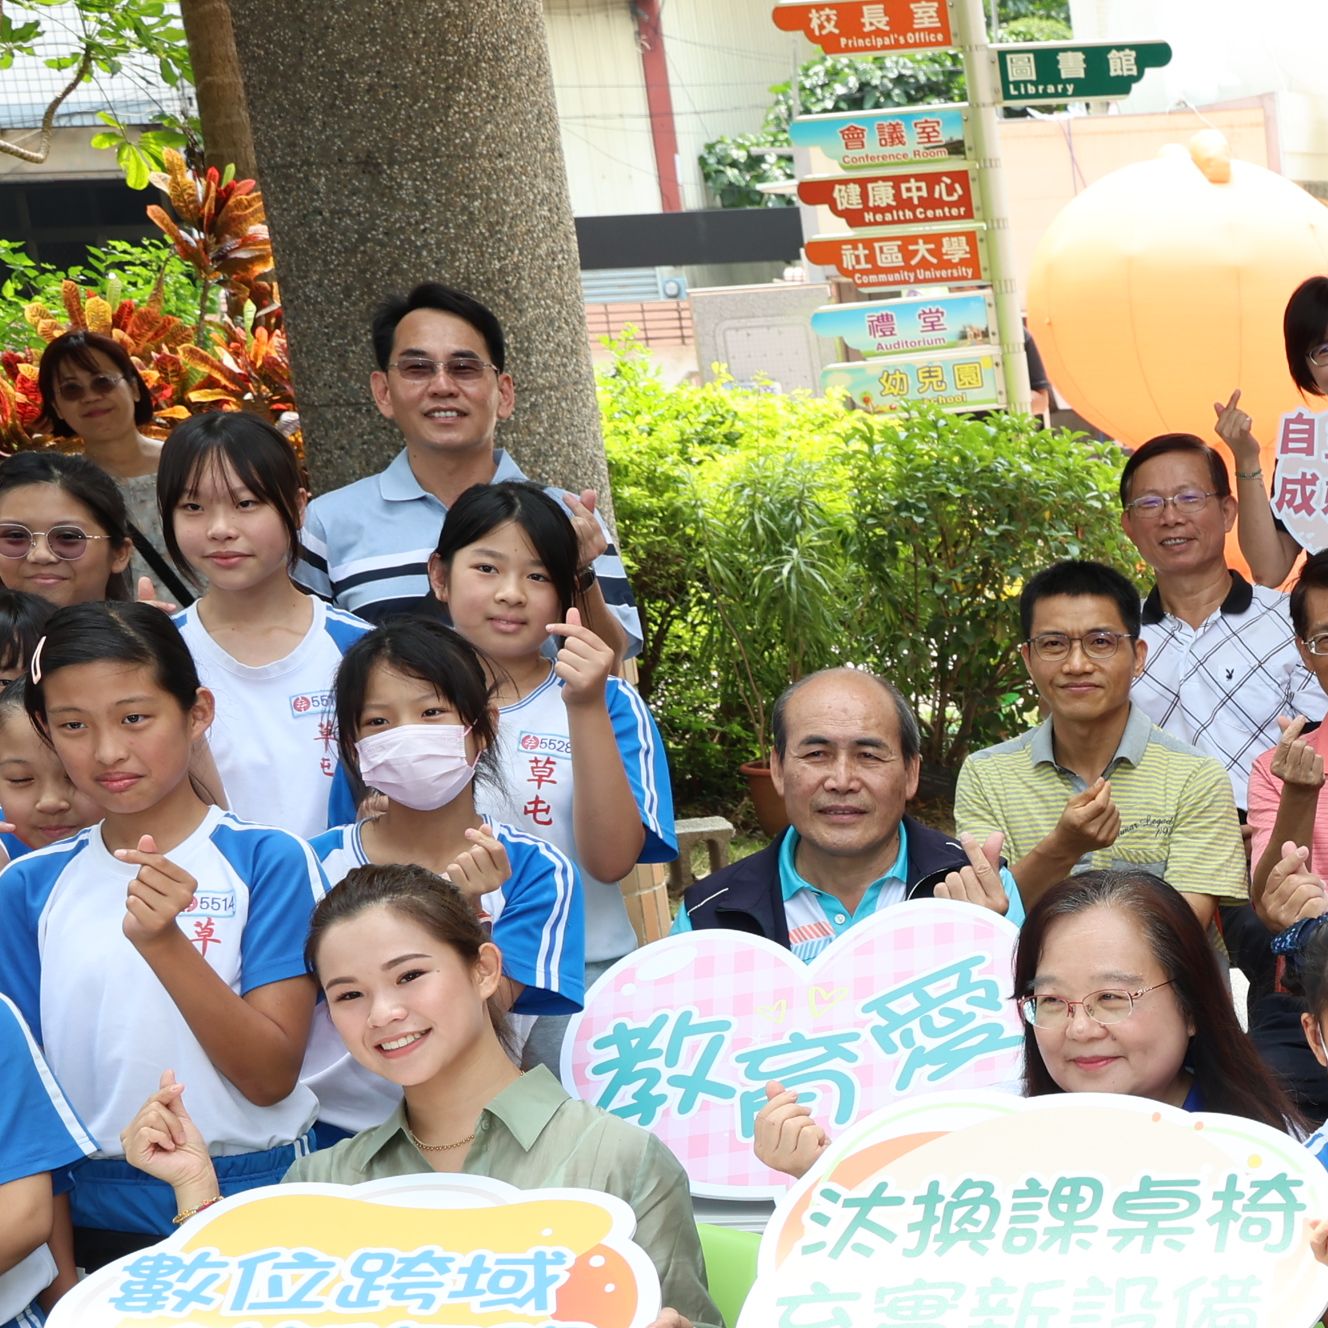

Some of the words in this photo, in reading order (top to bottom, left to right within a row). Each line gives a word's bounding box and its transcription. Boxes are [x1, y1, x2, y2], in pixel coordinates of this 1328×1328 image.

[808, 1, 941, 36] 校長室
[840, 34, 905, 48] Principal's
[907, 32, 944, 43] Office
[1006, 49, 1138, 82] 圖書館
[1009, 82, 1074, 96] Library
[839, 118, 945, 151] 會議室
[842, 150, 909, 165] Conference
[912, 148, 948, 160] Room
[832, 176, 964, 211] 健康中心
[864, 208, 913, 223] Health
[916, 206, 966, 219] Center
[841, 235, 971, 271] 社區大學
[854, 269, 915, 285] Community
[917, 266, 973, 281] University
[866, 307, 948, 339] 禮堂
[876, 336, 946, 351] Auditorium
[879, 361, 984, 397] 幼兒園
[523, 756, 558, 825] 草屯
[190, 917, 222, 959] 草
[590, 954, 1023, 1141] 教育愛
[801, 1172, 1304, 1260] 汰換課桌椅
[108, 1247, 570, 1314] 數位跨域
